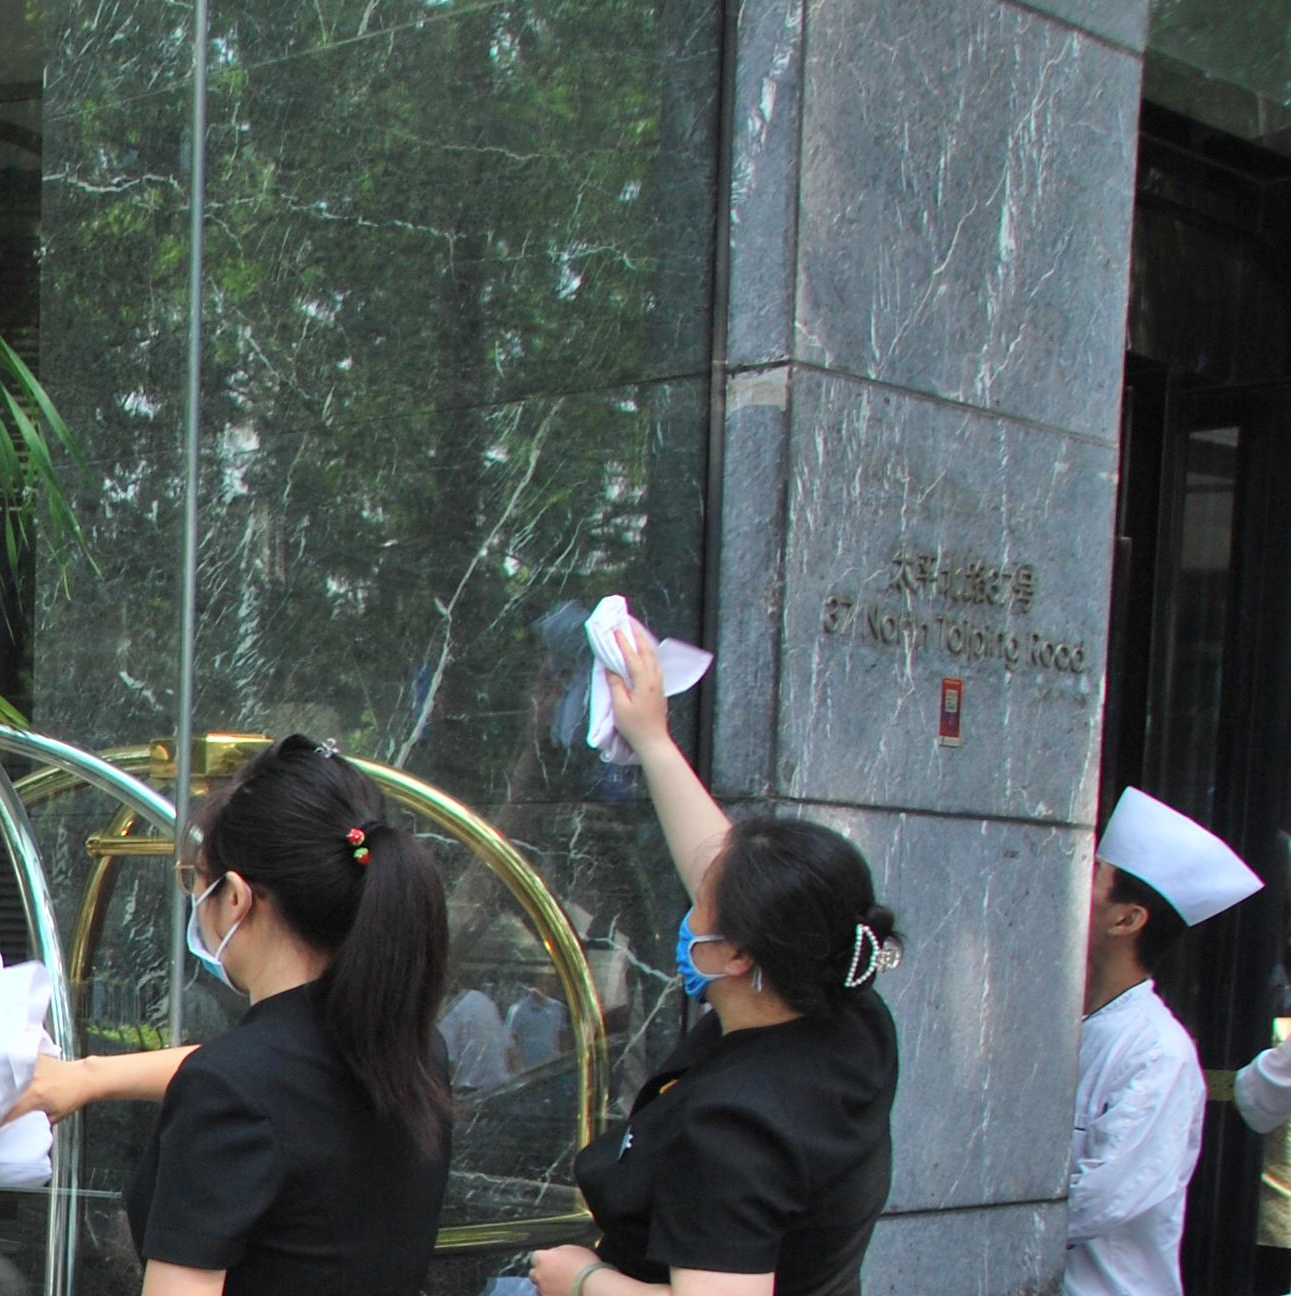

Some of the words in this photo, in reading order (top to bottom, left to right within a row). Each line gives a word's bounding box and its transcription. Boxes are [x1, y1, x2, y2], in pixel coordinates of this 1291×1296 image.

[889, 549, 1035, 615] 太平北路37号
[824, 596, 859, 636] 37
[863, 606, 930, 653] North
[935, 612, 1021, 672] Taiping
